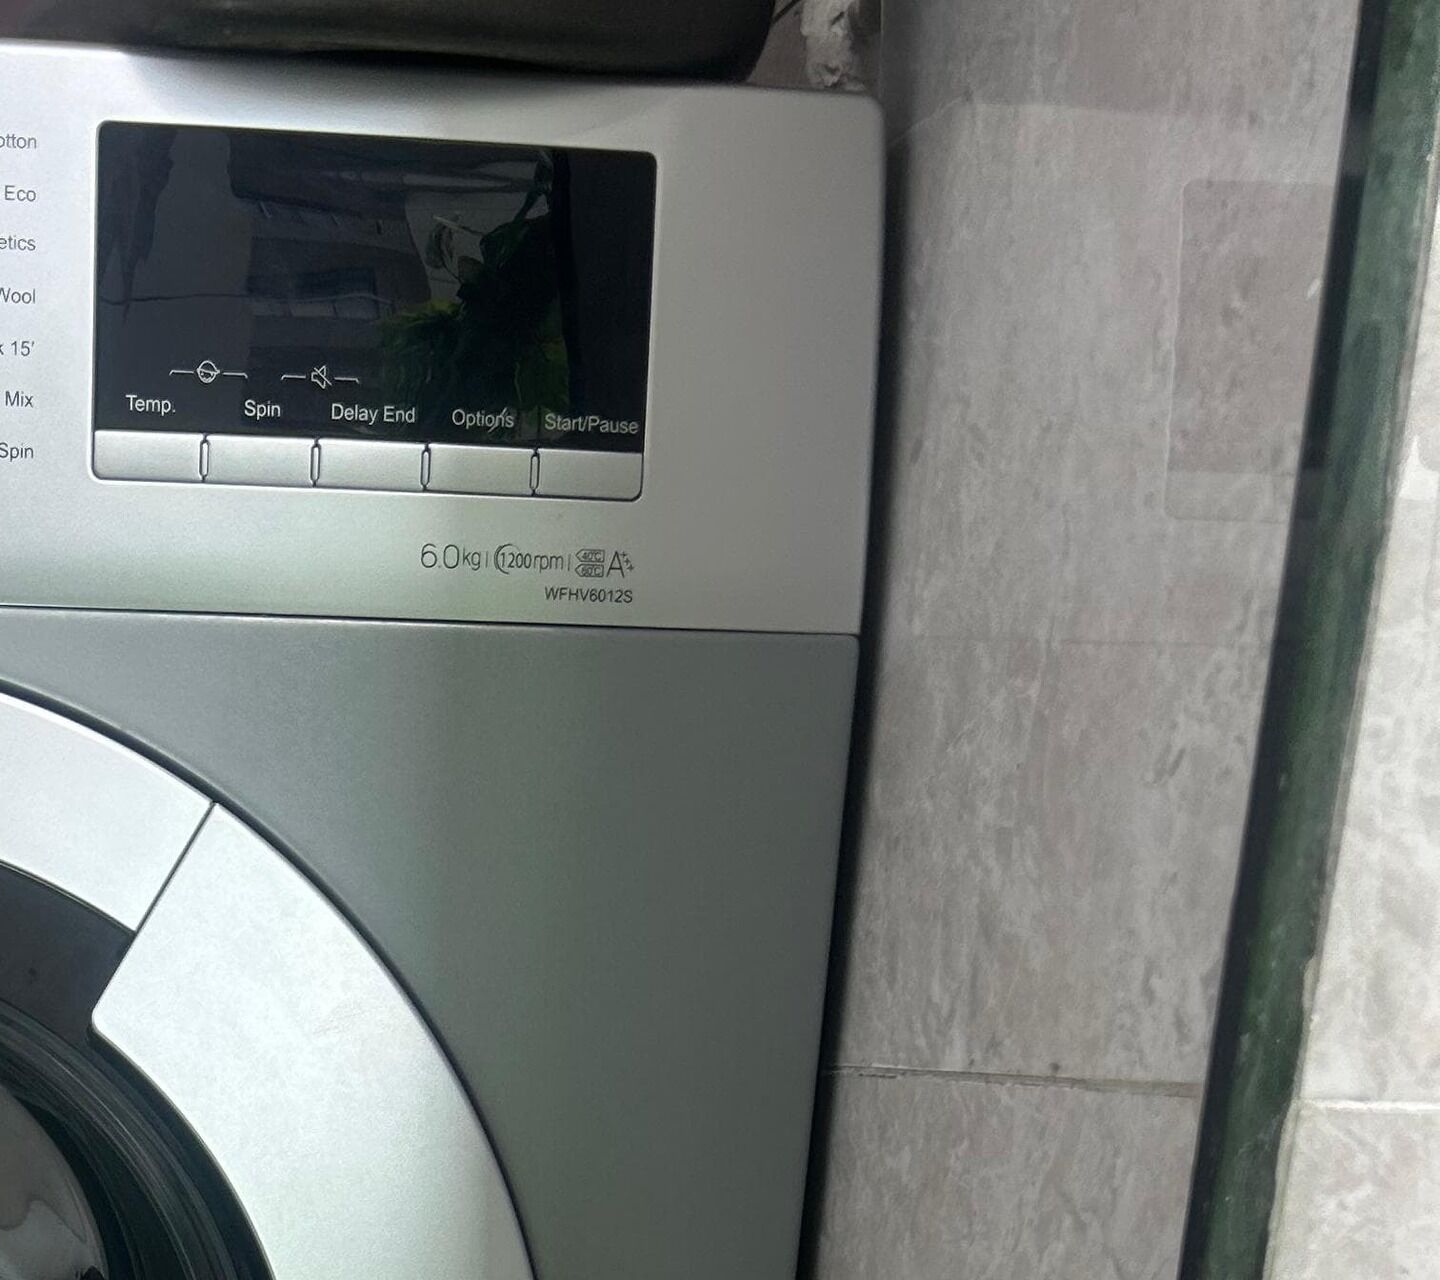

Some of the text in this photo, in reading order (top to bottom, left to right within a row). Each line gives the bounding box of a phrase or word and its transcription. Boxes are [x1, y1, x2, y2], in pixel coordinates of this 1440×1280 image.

[5, 185, 36, 202] Eco
[11, 341, 34, 356] 15'
[6, 391, 33, 407] Mix
[126, 395, 175, 416] Temp.
[245, 400, 280, 420] Spin
[332, 403, 415, 425] Delay End
[452, 408, 514, 431] Options
[545, 413, 638, 434] Start/Pause
[545, 587, 632, 603] WFHV6012S
